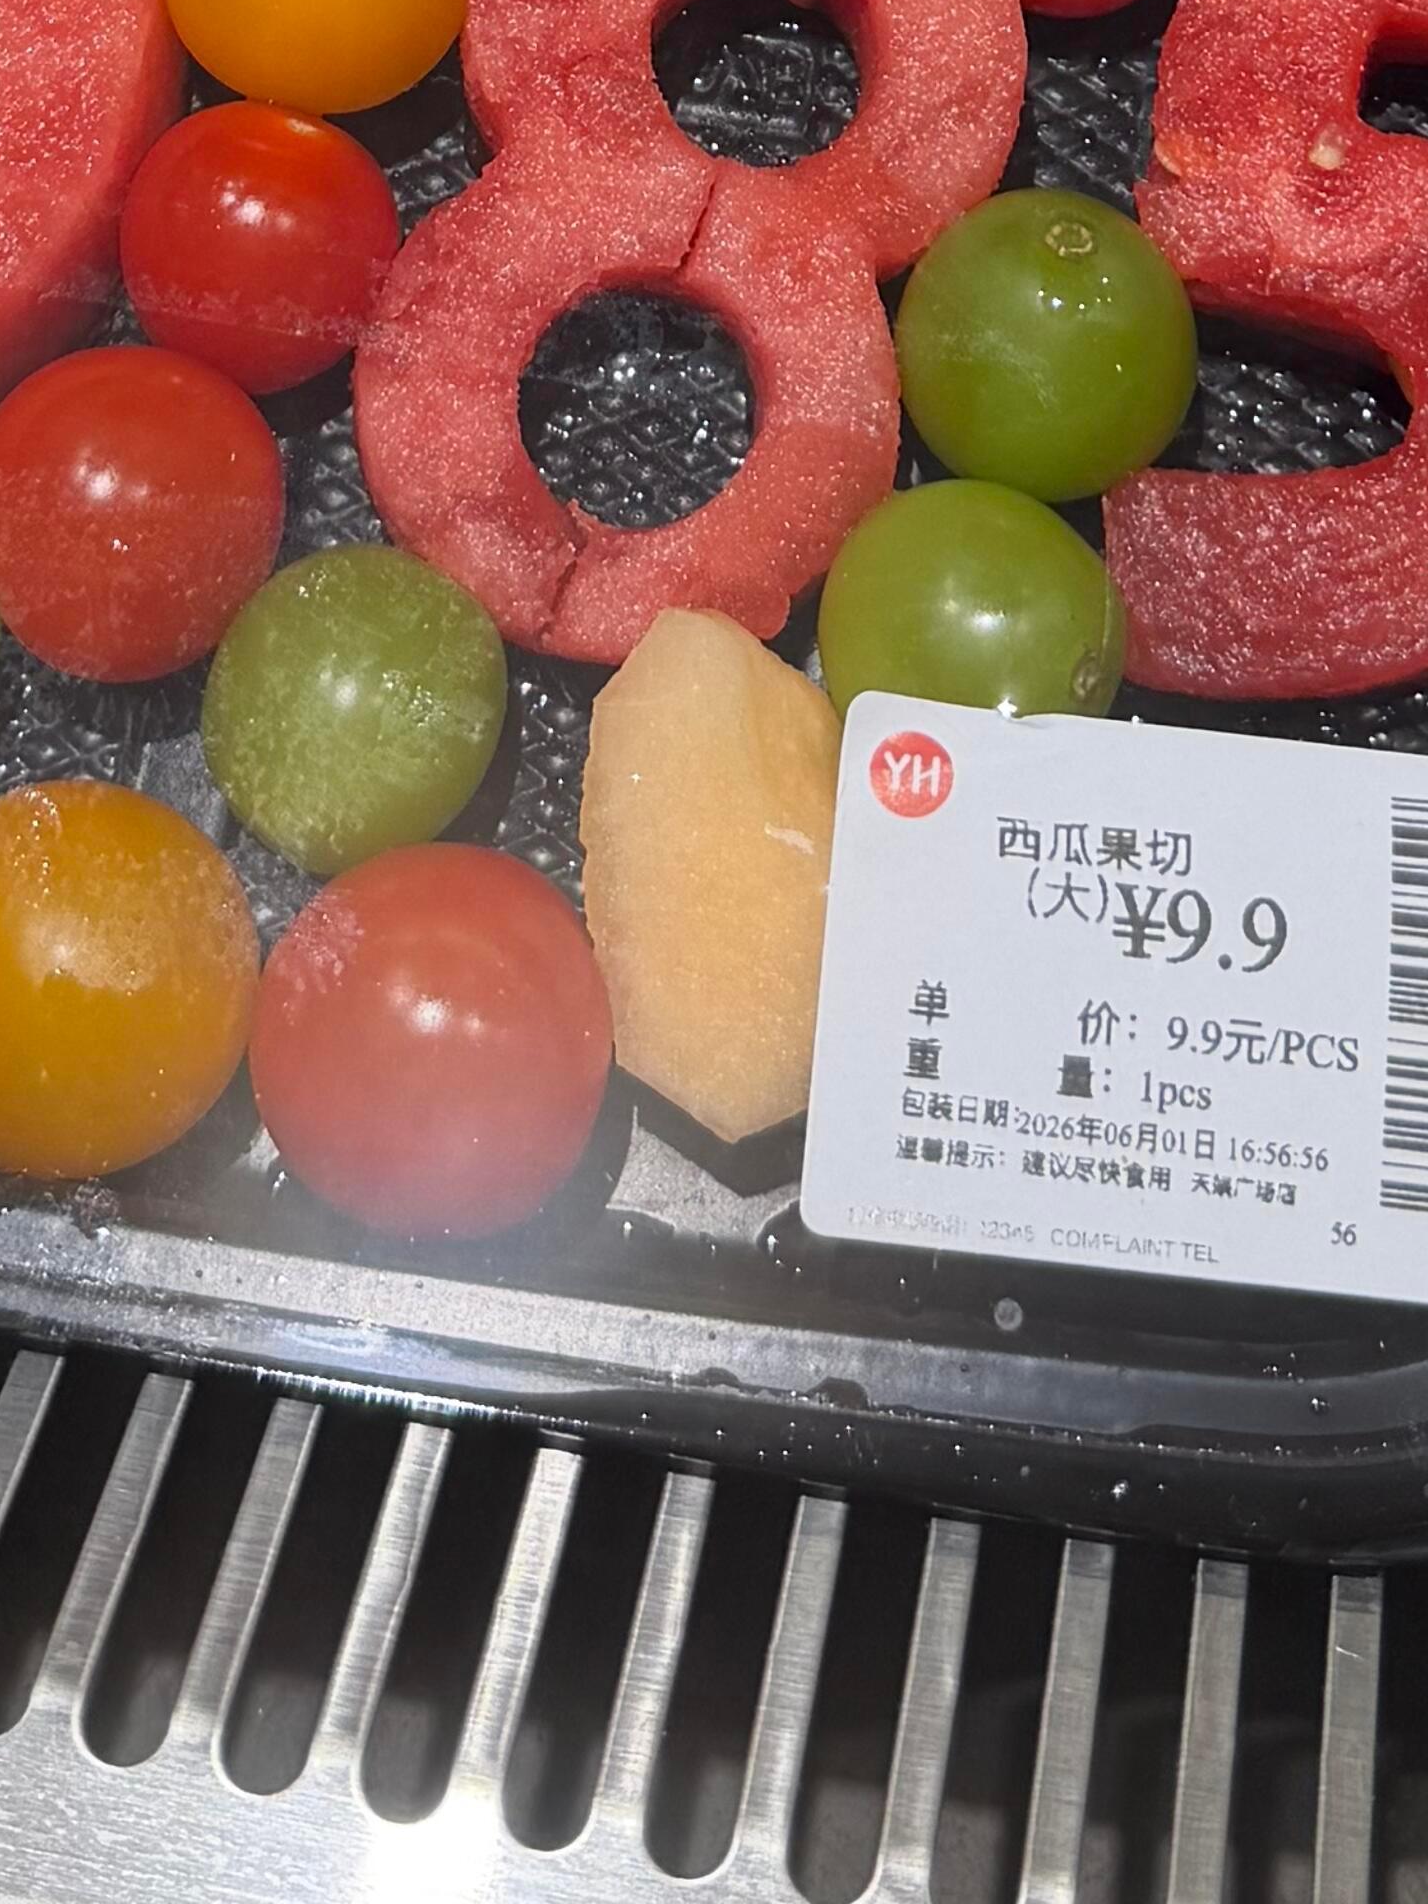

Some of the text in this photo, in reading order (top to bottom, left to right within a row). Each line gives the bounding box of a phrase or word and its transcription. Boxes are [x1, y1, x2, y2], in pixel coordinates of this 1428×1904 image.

[883, 750, 941, 798] YH
[996, 816, 1193, 877] 西瓜果切
[1112, 881, 1289, 973] ¥9.9
[908, 978, 950, 1027] 单
[1167, 1016, 1360, 1073] 9.9元/PCS
[903, 1037, 942, 1080] 重
[1140, 1071, 1213, 1115] 1pcs
[1229, 1136, 1330, 1172] 16:56:56
[1180, 1241, 1221, 1264] TEL
[1330, 1221, 1358, 1247] 56
